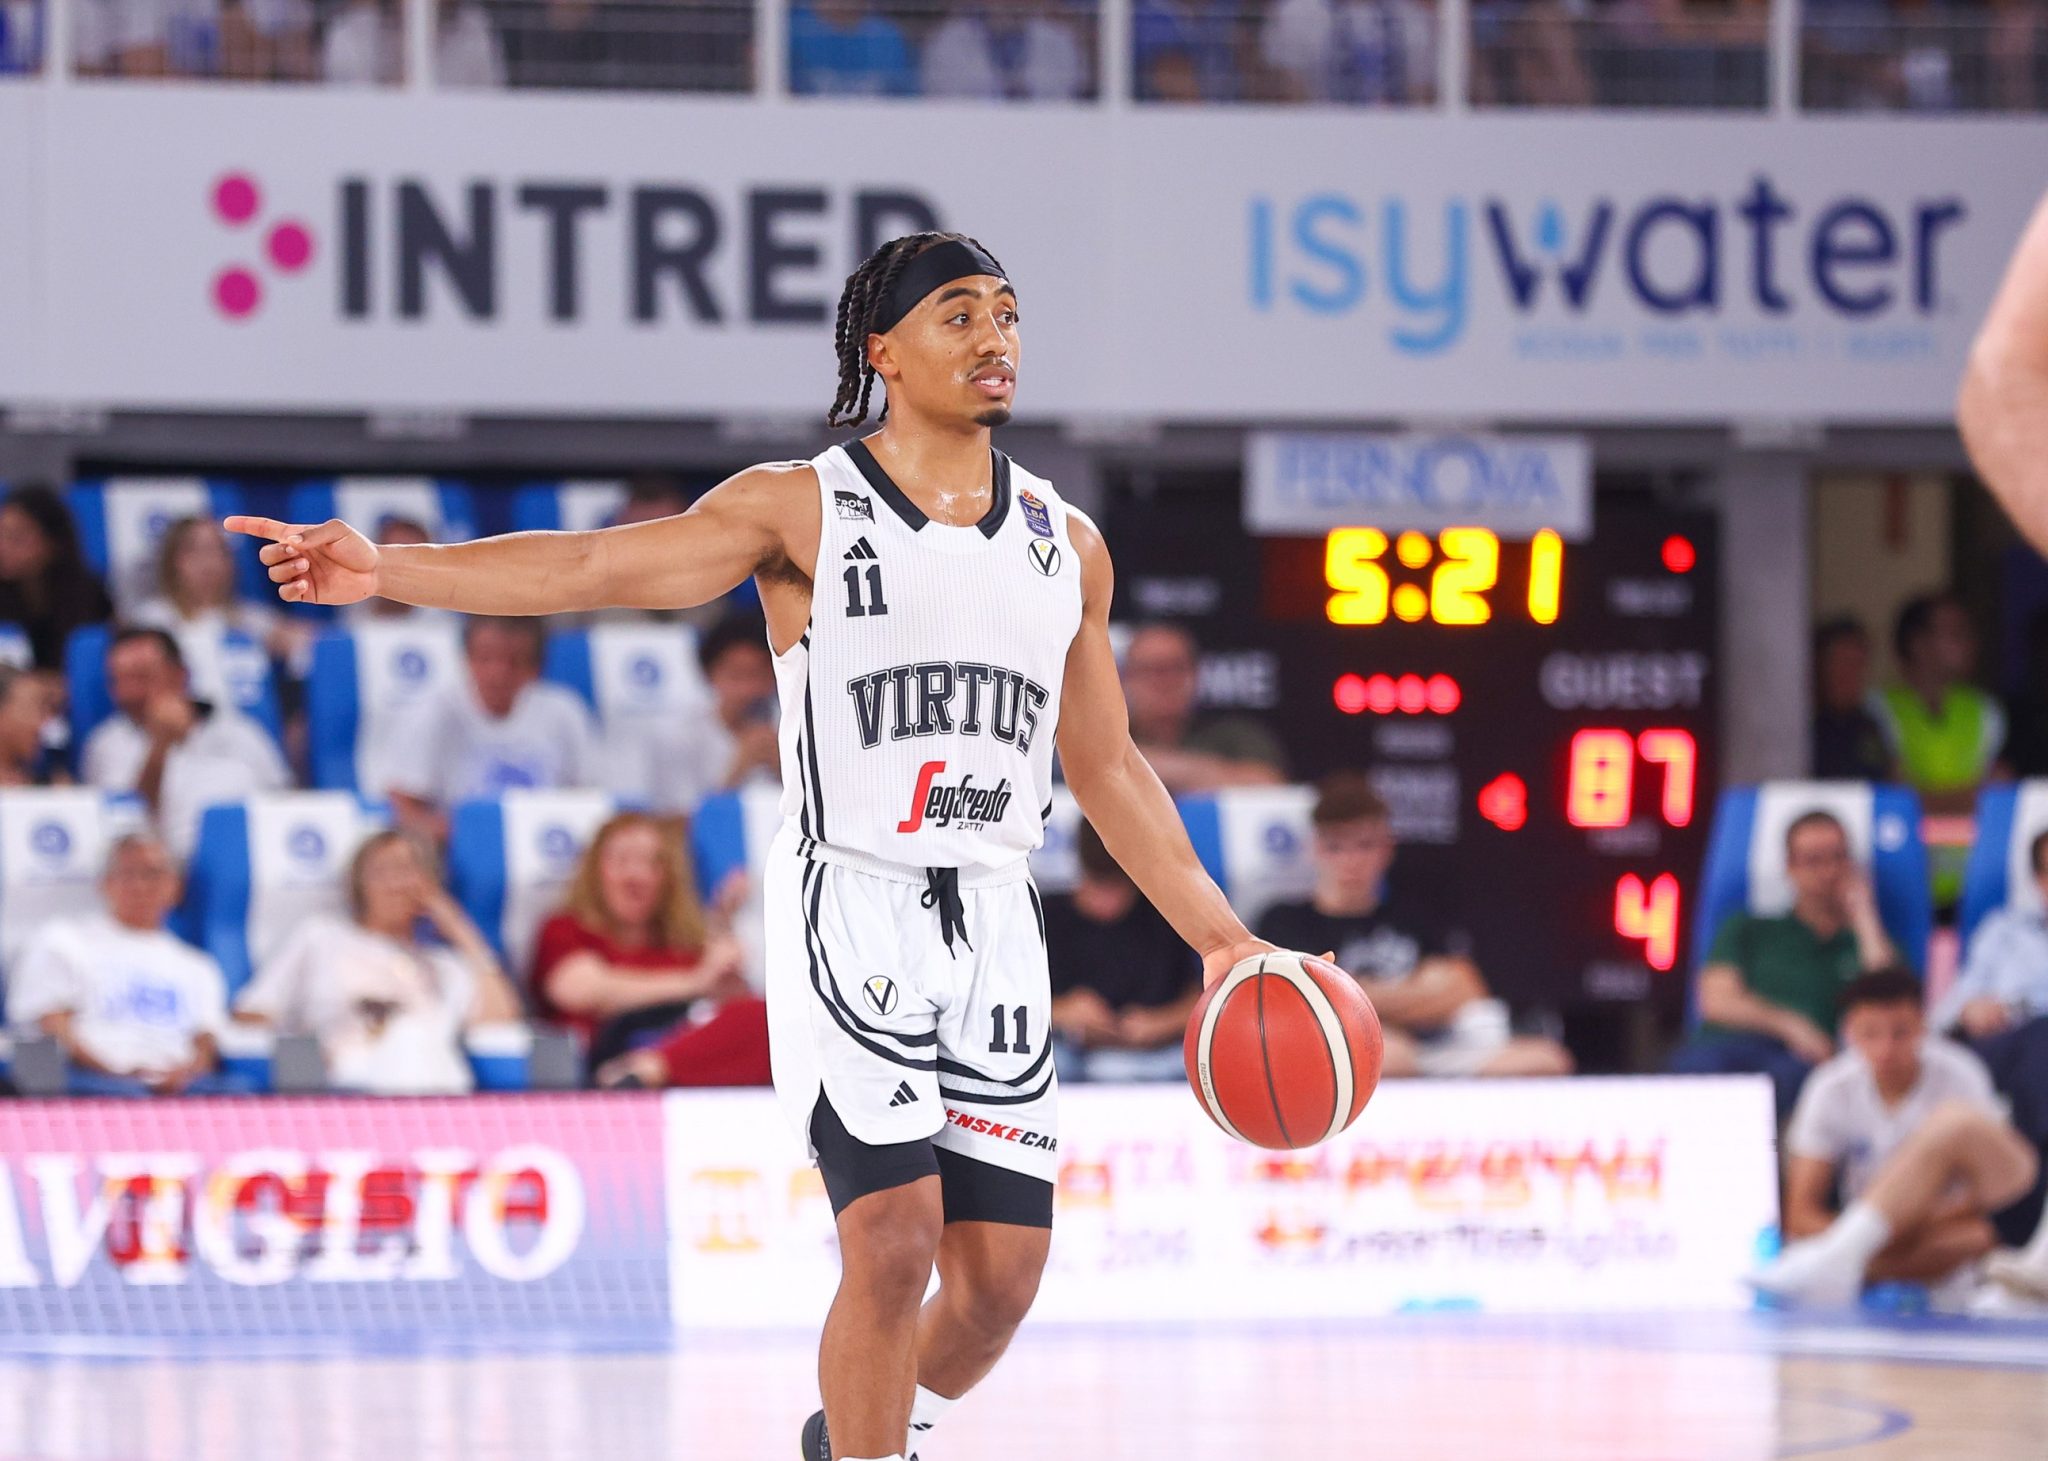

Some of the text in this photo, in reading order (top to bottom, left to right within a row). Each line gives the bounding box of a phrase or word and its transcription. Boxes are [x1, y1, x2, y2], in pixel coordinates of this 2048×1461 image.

[1024, 506, 1047, 521] LBA
[843, 564, 888, 617] 11
[1325, 526, 1563, 624] 5:21
[847, 661, 1050, 756] VIRTUS
[1540, 650, 1705, 709] GUEST
[897, 761, 1012, 833] Segafredo
[1567, 728, 1697, 828] 87
[1614, 872, 1680, 971] 4
[989, 1004, 1031, 1054] 11
[945, 1108, 1058, 1152] ENSKECAR
